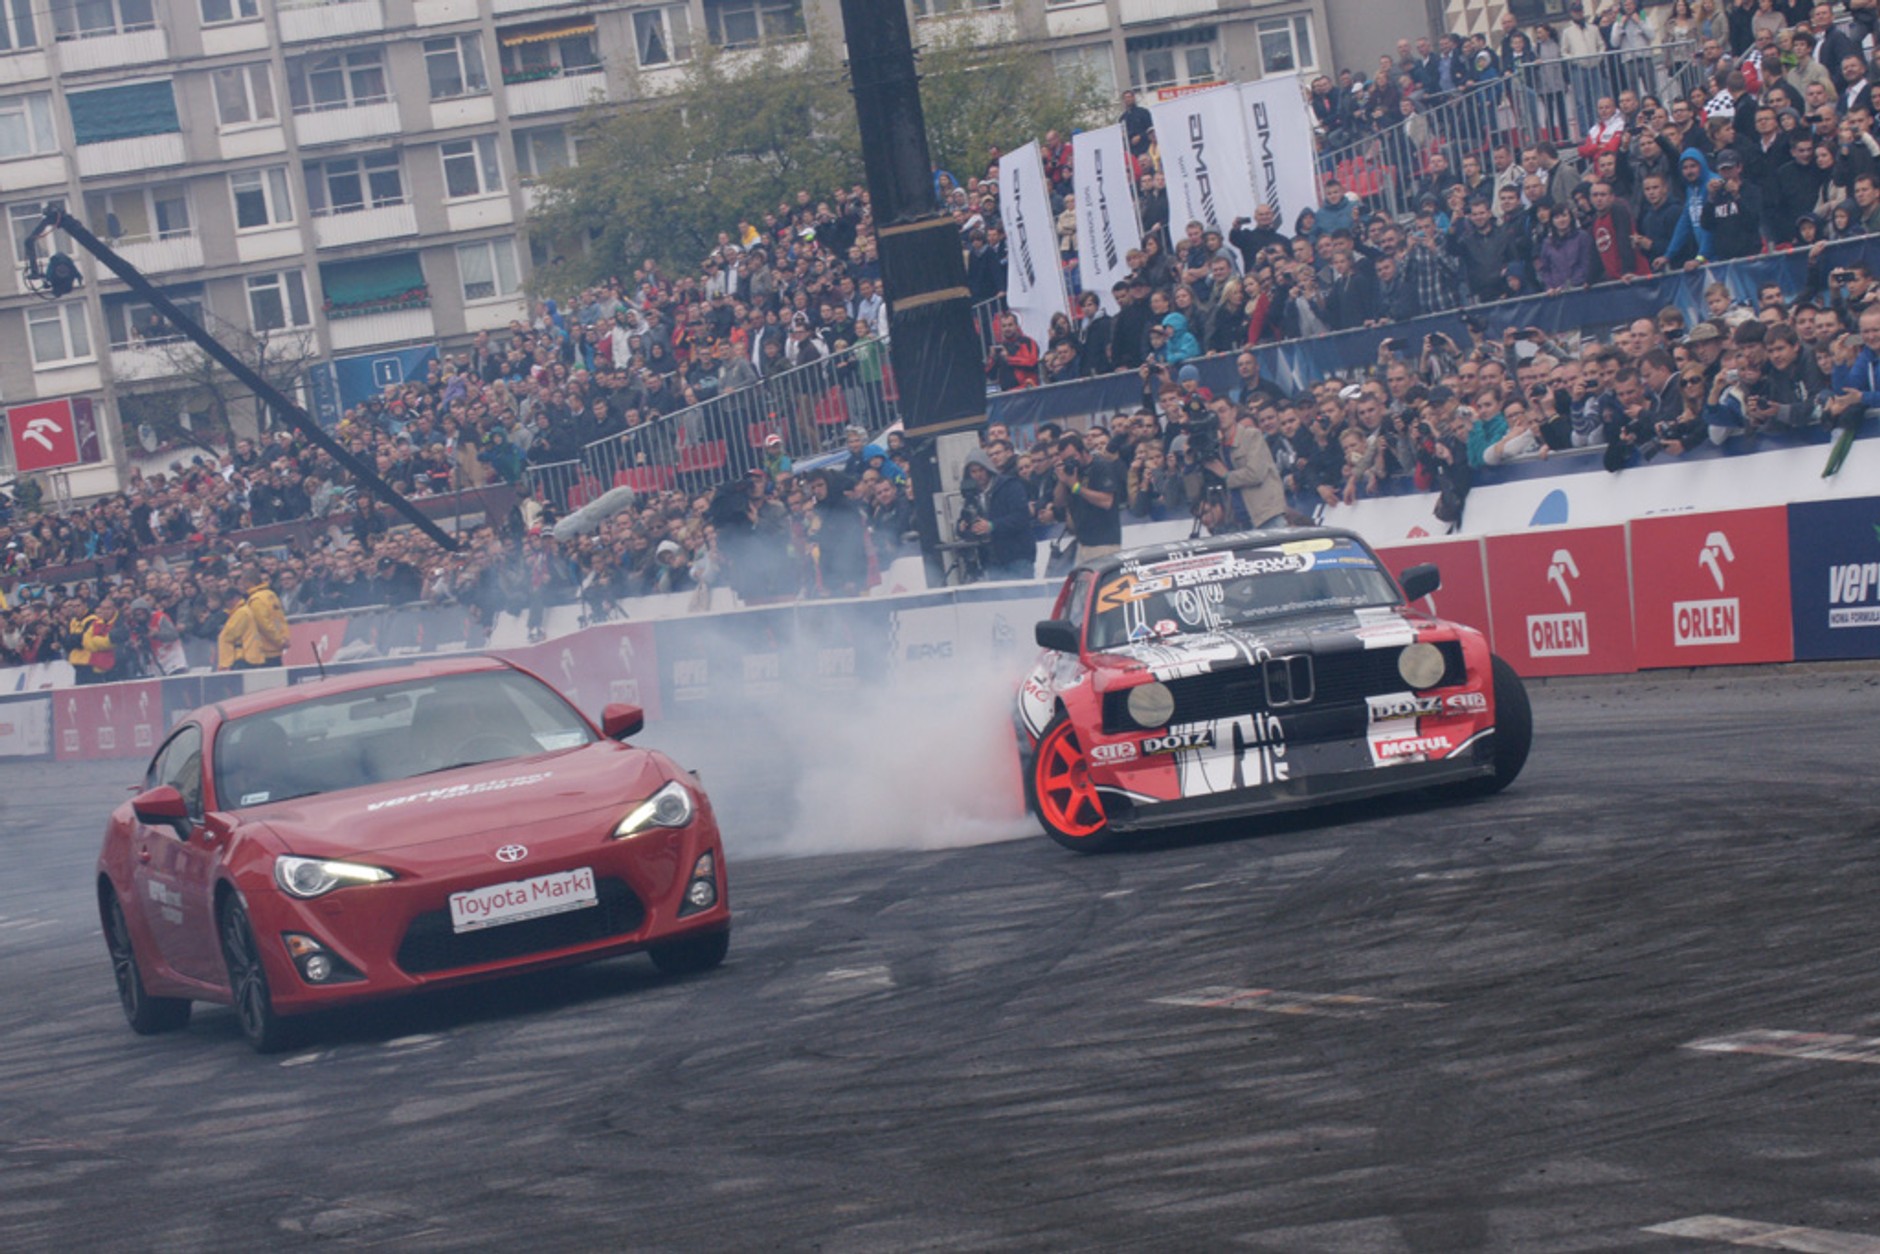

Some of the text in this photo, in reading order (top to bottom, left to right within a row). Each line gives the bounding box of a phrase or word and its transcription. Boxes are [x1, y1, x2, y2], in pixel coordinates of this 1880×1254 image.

[1531, 618, 1585, 652] ORLEN
[1678, 605, 1735, 640] ORLEN
[1374, 696, 1442, 717] DOTZ
[1144, 730, 1210, 753] DOTZ
[1381, 736, 1452, 757] MOTUL
[453, 889, 528, 917] Toyota
[531, 872, 592, 901] Marki
